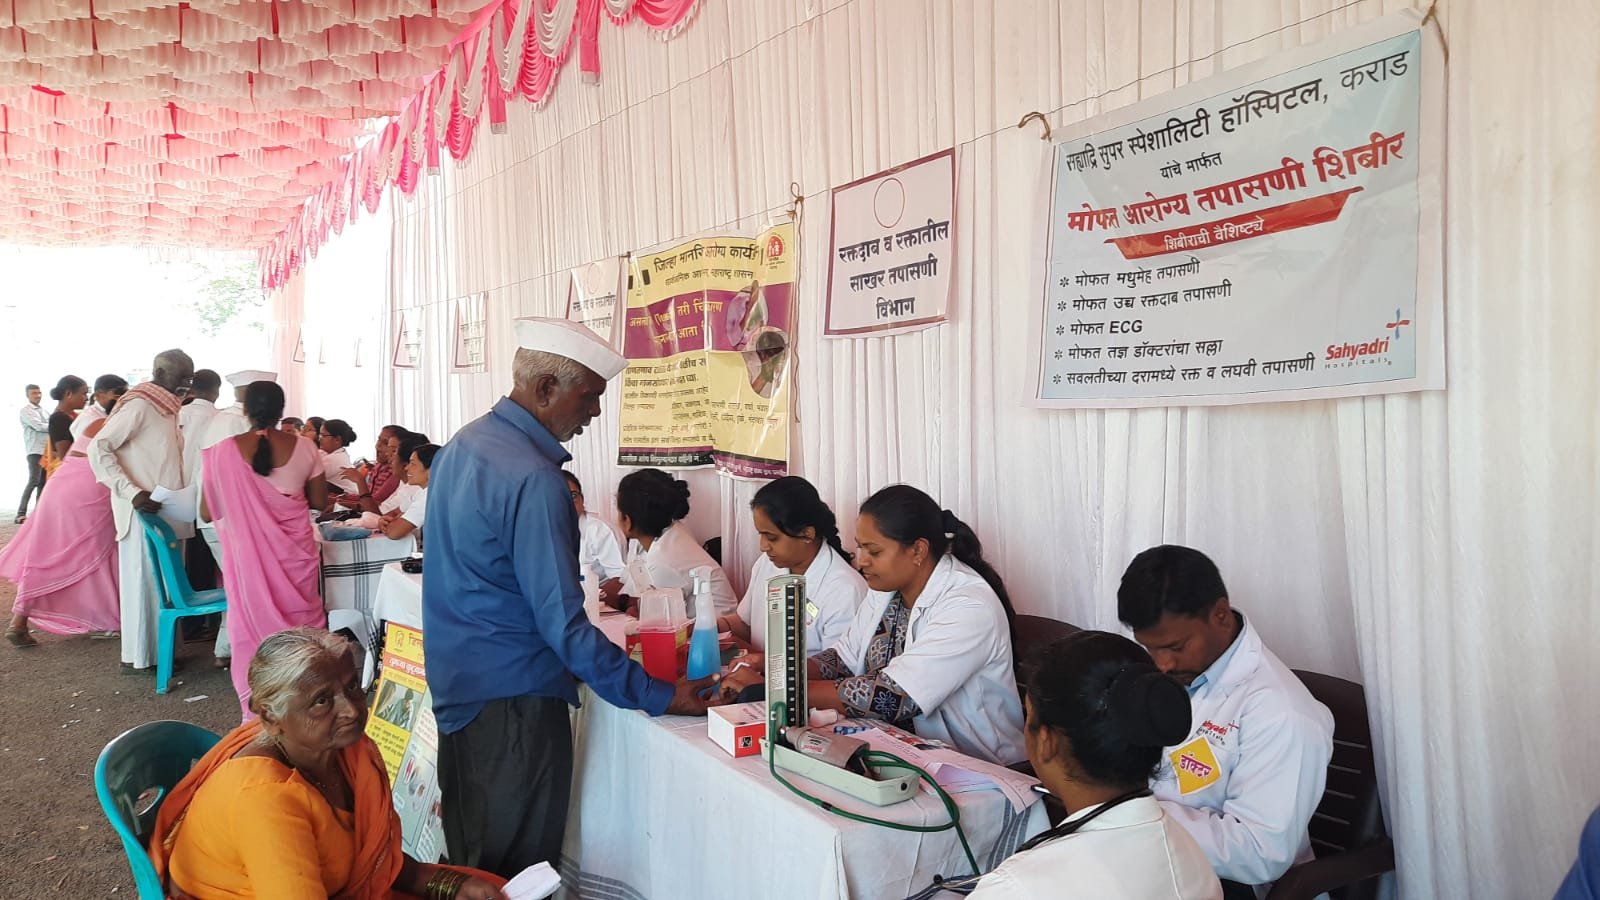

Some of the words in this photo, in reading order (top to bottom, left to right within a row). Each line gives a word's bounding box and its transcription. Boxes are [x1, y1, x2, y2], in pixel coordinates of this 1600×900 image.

[1098, 141, 1124, 170] सुपर
[1128, 107, 1210, 155] स्पेशालिटी
[1220, 78, 1328, 134] हॉस्पिटल,
[1340, 50, 1411, 92] कराड
[1067, 202, 1120, 231] मोफत
[1122, 191, 1191, 226] आरोग्य
[1194, 157, 1306, 213] तपासणी
[1313, 131, 1406, 183] शिबीर
[1160, 159, 1182, 180] यांचे
[1186, 152, 1223, 174] मार्फत
[838, 238, 881, 263] रक्तदाब
[883, 236, 894, 252] व
[895, 218, 950, 250] रक्तातील
[1163, 228, 1211, 252] शिबीराची
[849, 270, 886, 293] साखर
[888, 252, 938, 286] तपासणी
[1074, 268, 1110, 287] मोफत
[1116, 266, 1152, 290] मधुमेह
[1156, 257, 1201, 281] तपासणी
[876, 297, 916, 320] विभाग
[1072, 294, 1107, 312] मोफत
[1112, 294, 1135, 310] उच्च
[1140, 286, 1179, 308] रक्तदाब
[1183, 278, 1233, 304] तपासणी
[1069, 318, 1105, 335] मोफत
[1109, 320, 1143, 335] ECG
[1068, 344, 1102, 360] मोफत
[1107, 344, 1129, 360] तज्ञ
[1133, 339, 1190, 358] डॉक्टरांचा
[1195, 339, 1224, 357] सल्ला
[1325, 336, 1389, 362] Sahyadri
[1066, 366, 1127, 386] सवलतीच्या
[1131, 364, 1176, 384] दरामध्ये
[1180, 366, 1201, 381] रक्त
[1206, 366, 1216, 379] व
[1220, 359, 1257, 379] लघवी
[1262, 354, 1316, 375] तपासणी
